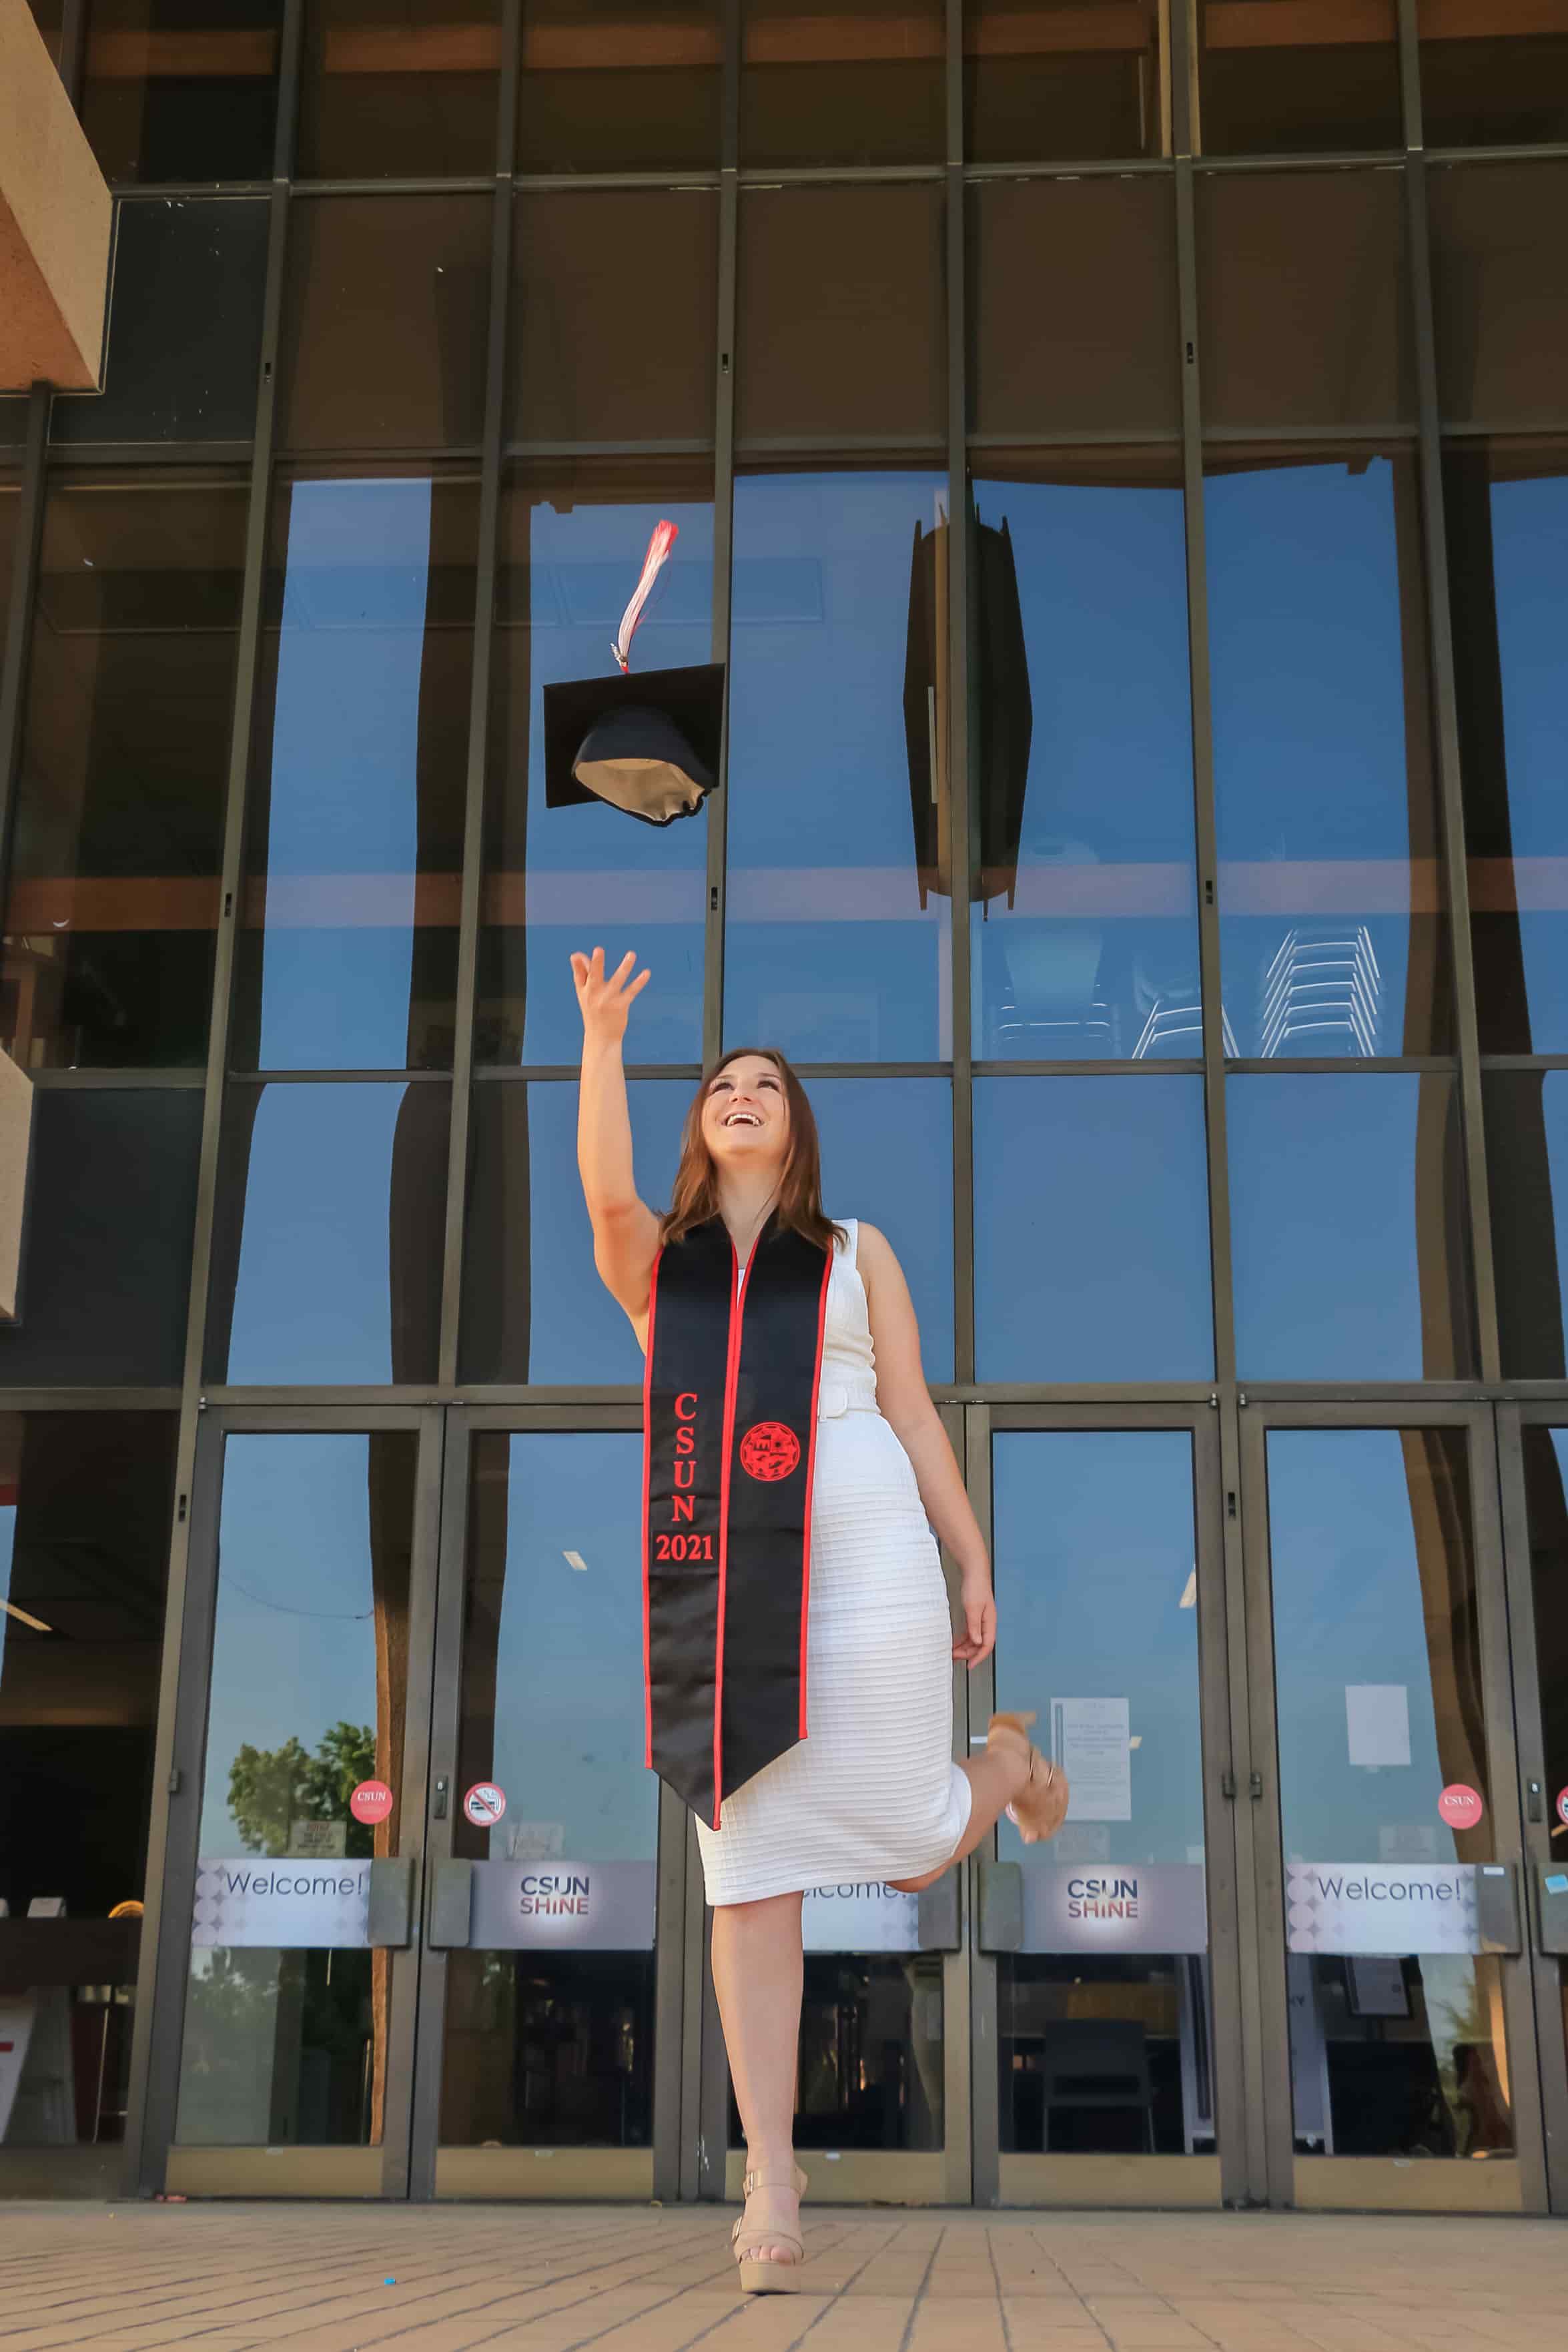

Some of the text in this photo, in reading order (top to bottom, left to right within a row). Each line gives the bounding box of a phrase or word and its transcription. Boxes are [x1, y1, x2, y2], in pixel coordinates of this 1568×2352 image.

[671, 1392, 698, 1523] CSUN
[655, 1534, 714, 1561] 2021
[356, 1791, 386, 1802] CSUN
[1443, 1796, 1475, 1806] CSUN
[226, 1871, 363, 1896] Welcome!
[520, 1876, 590, 1896] CSUN
[1067, 1879, 1138, 1900] CSUN
[1317, 1876, 1461, 1901] Welcome!
